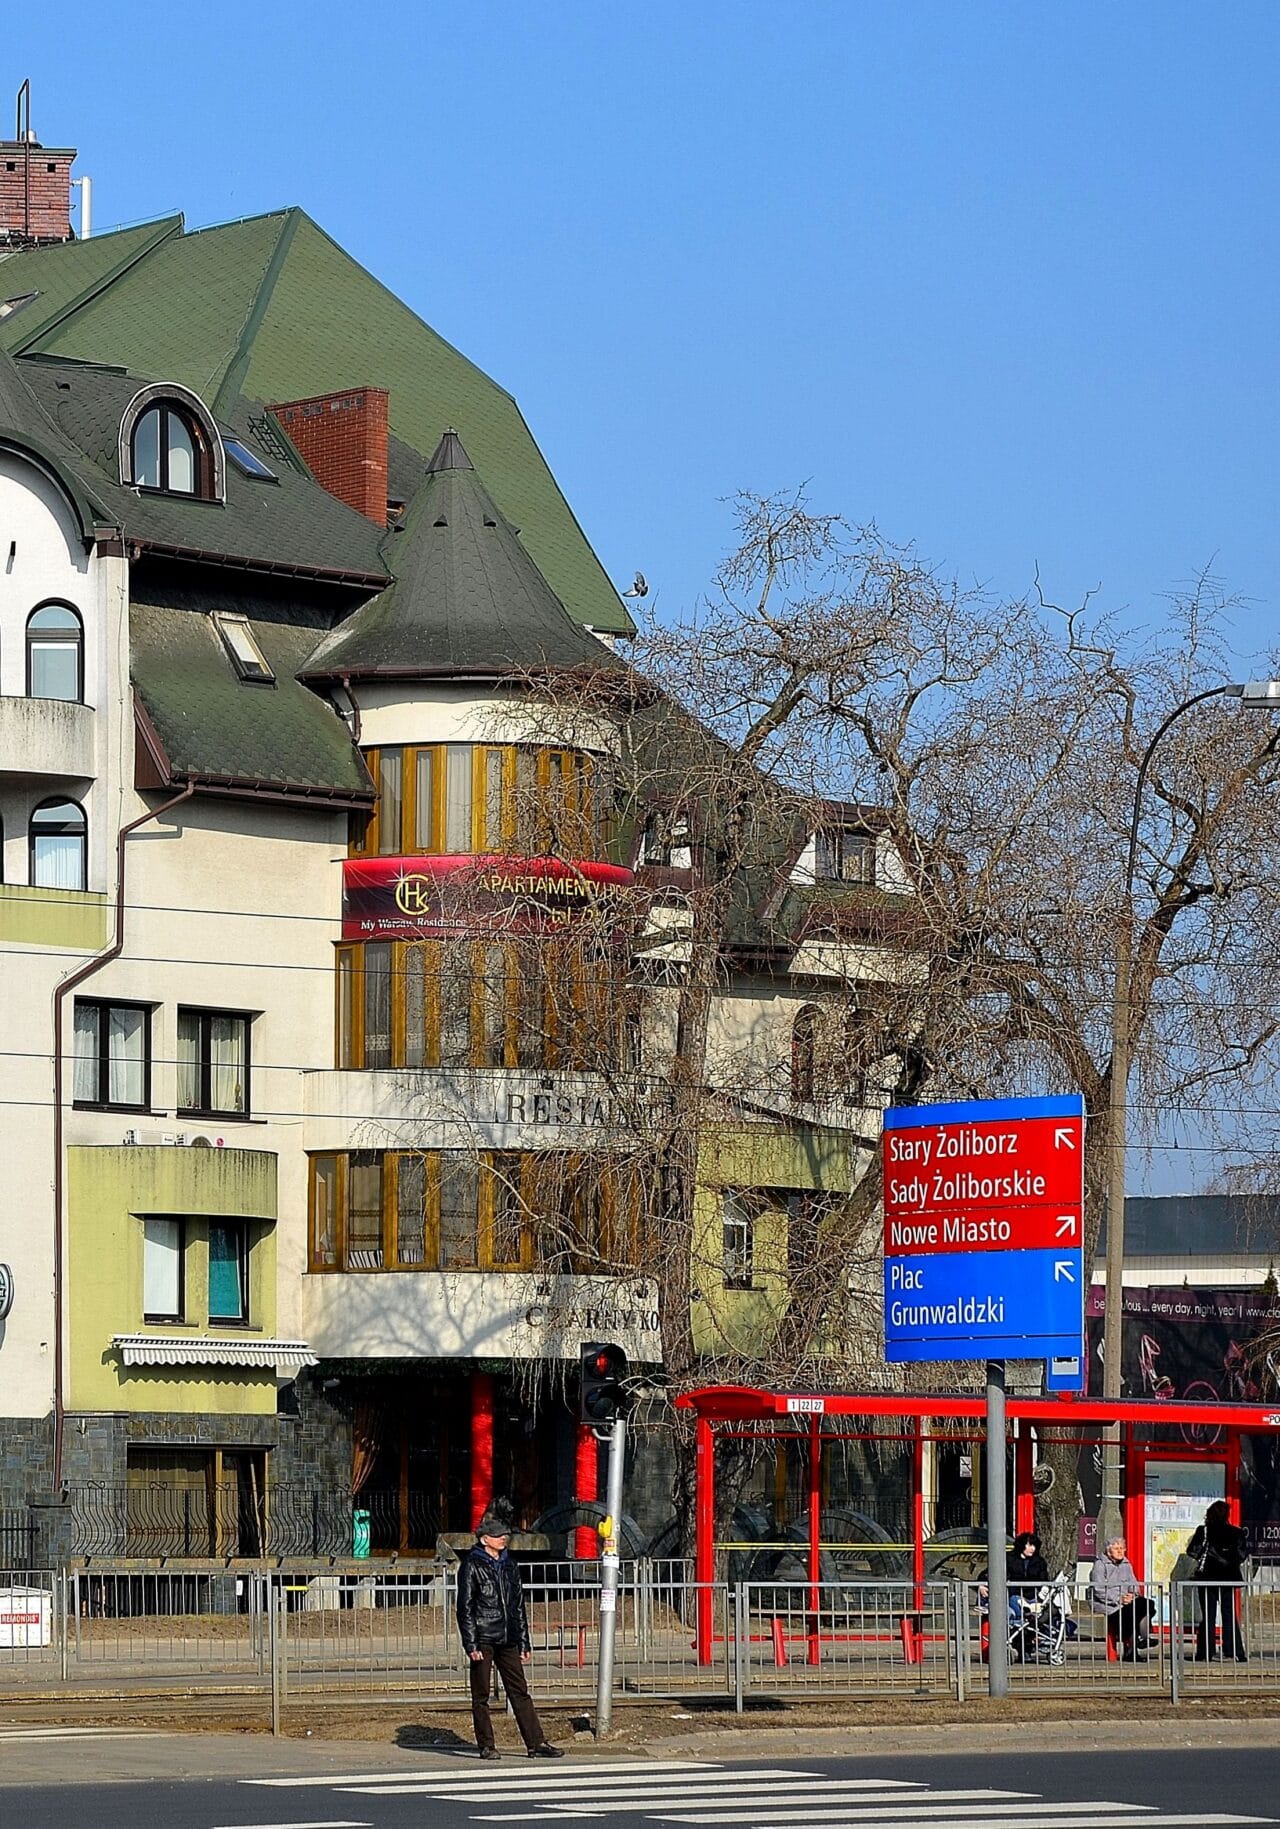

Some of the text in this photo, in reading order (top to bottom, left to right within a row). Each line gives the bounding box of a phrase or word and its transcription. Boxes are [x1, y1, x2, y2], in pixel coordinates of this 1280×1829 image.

[361, 920, 375, 931] My
[890, 1125, 1018, 1166] Stary Żoliborz
[890, 1168, 1045, 1209] Sady Żoliborskie
[891, 1217, 1010, 1246] Nowe Miasto
[891, 1264, 923, 1290] Plac
[891, 1296, 1004, 1326] Grunwaldzki
[1151, 1303, 1174, 1315] every
[1175, 1301, 1193, 1316] day,
[801, 1401, 810, 1410] 22
[814, 1401, 823, 1411] 27
